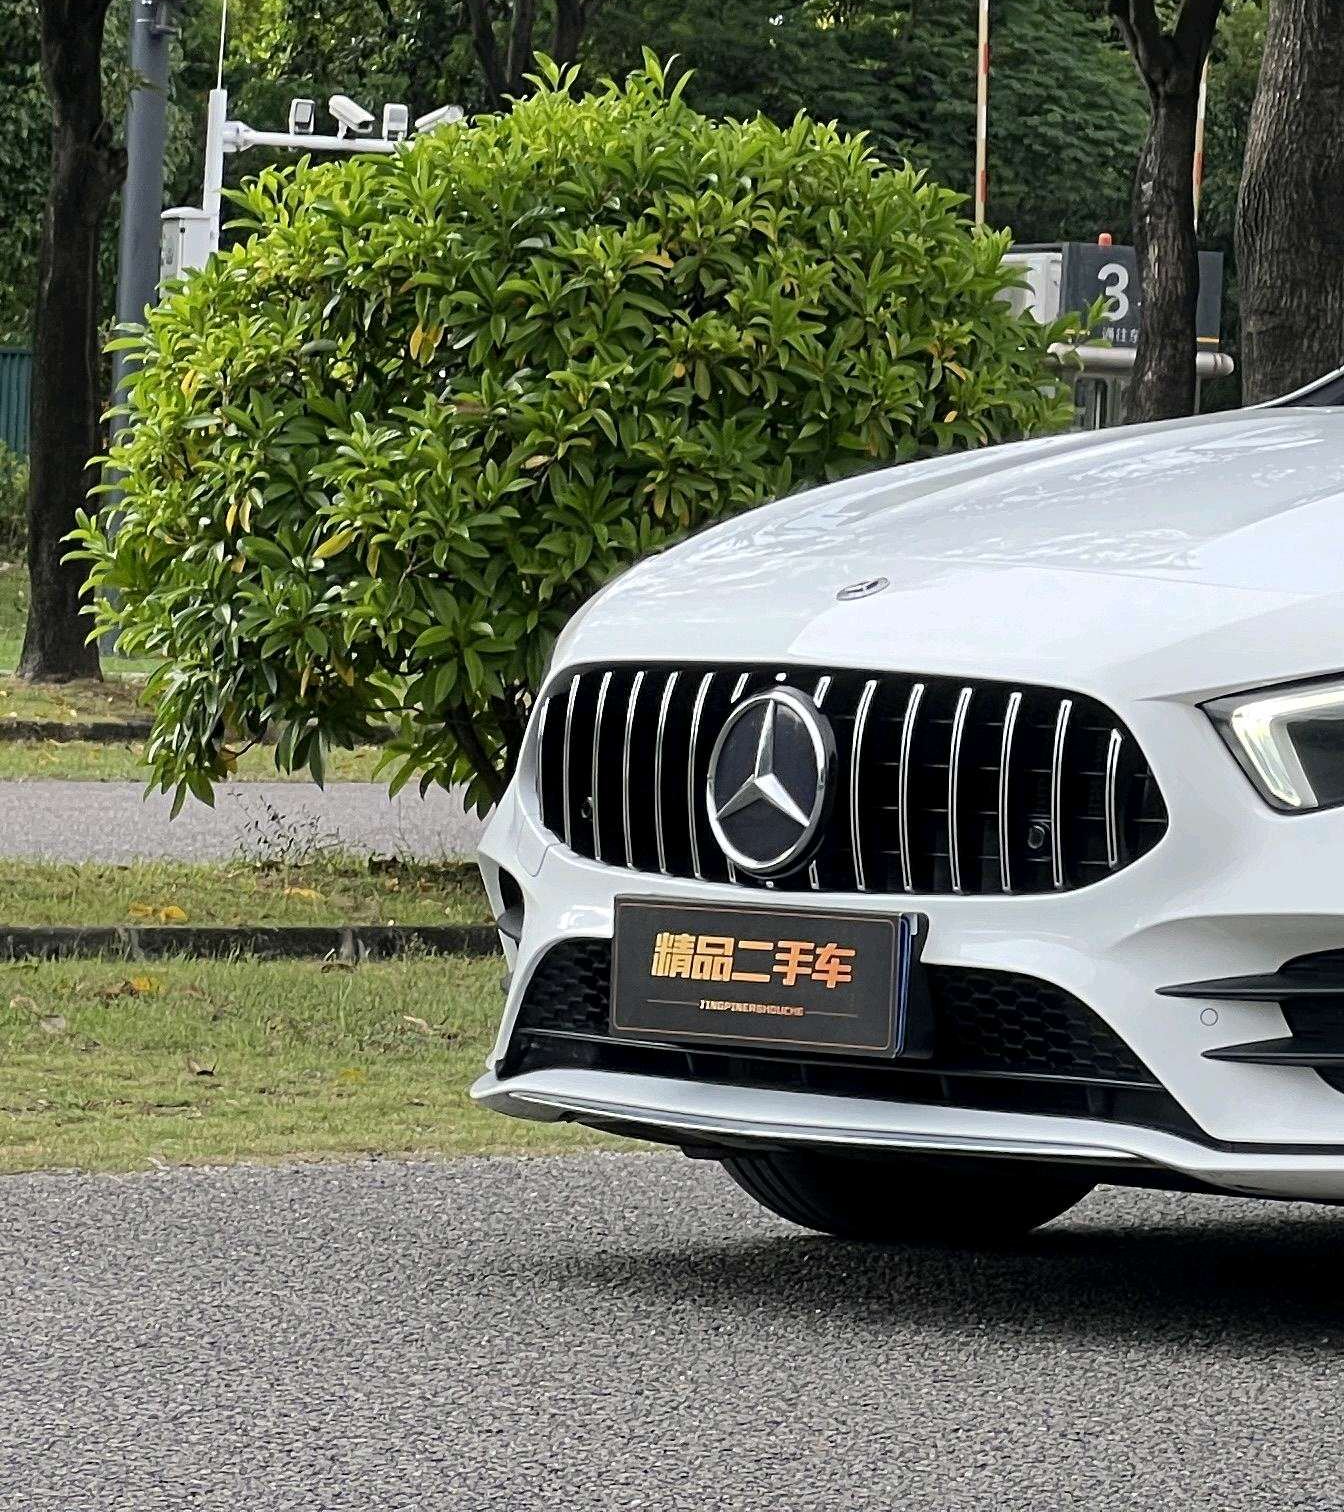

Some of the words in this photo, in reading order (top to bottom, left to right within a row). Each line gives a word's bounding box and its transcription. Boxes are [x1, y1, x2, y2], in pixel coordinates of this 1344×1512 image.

[651, 931, 856, 989] 精品二手车
